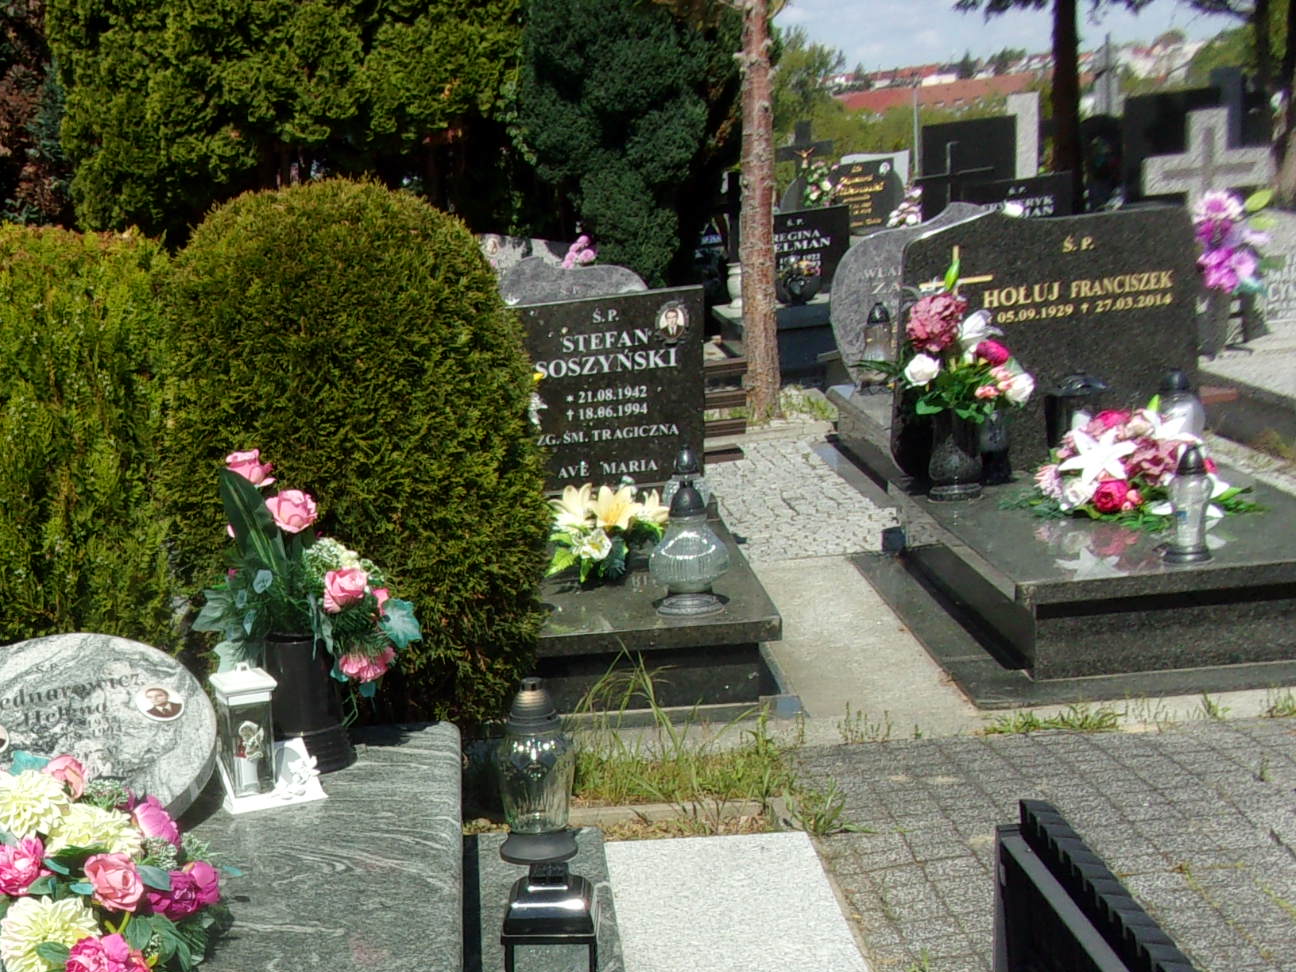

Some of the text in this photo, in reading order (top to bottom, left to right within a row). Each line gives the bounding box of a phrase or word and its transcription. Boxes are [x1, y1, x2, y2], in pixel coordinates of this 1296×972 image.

[982, 270, 1174, 309] HOŁUJ FRANCISZEK
[997, 292, 1174, 324] 05.09.1929 27.03.2014
[561, 327, 651, 353] STEFAN
[535, 346, 678, 380] SOSZYŃSKI
[577, 385, 648, 404] 21.08.1942
[591, 423, 680, 443] TRAGICZNA
[558, 459, 658, 479] AVE MARIA
